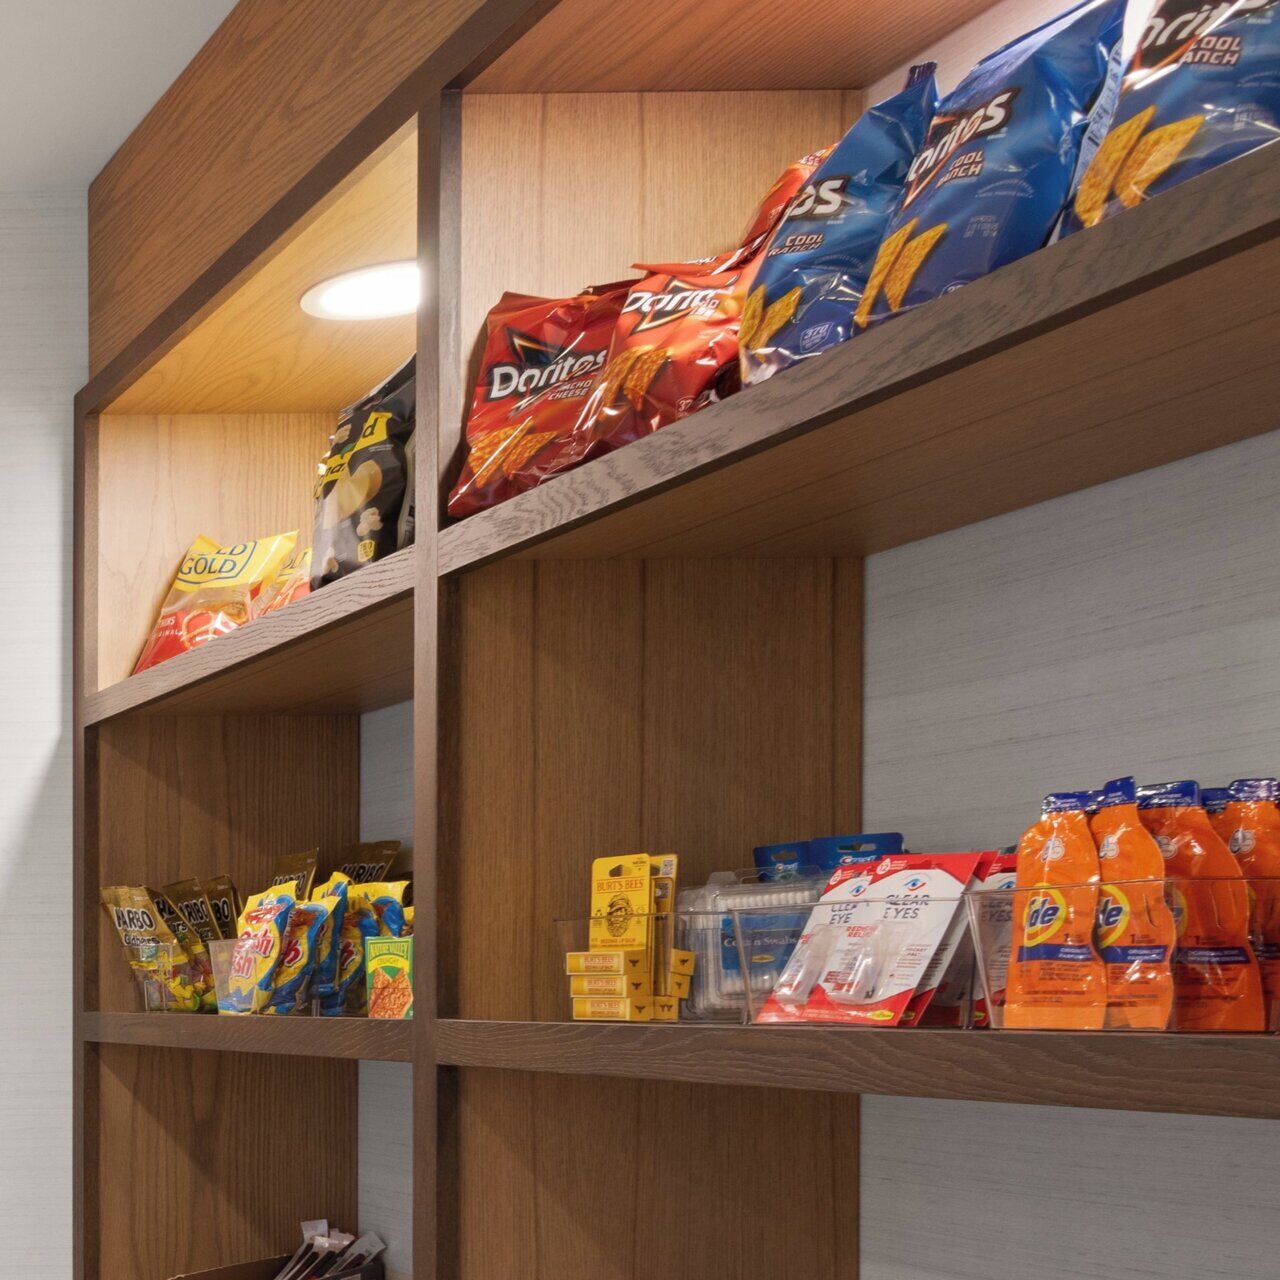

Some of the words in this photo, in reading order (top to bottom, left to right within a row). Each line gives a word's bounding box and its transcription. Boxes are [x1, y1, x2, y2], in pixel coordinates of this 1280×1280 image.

[909, 92, 1014, 181] oritos
[786, 233, 825, 248] COOL
[490, 350, 607, 399] Doritos
[548, 388, 589, 401] CHEESE
[180, 556, 238, 576] GOLD
[596, 879, 623, 892] BURT'S
[625, 878, 644, 890] BEES
[829, 912, 851, 925] EYE
